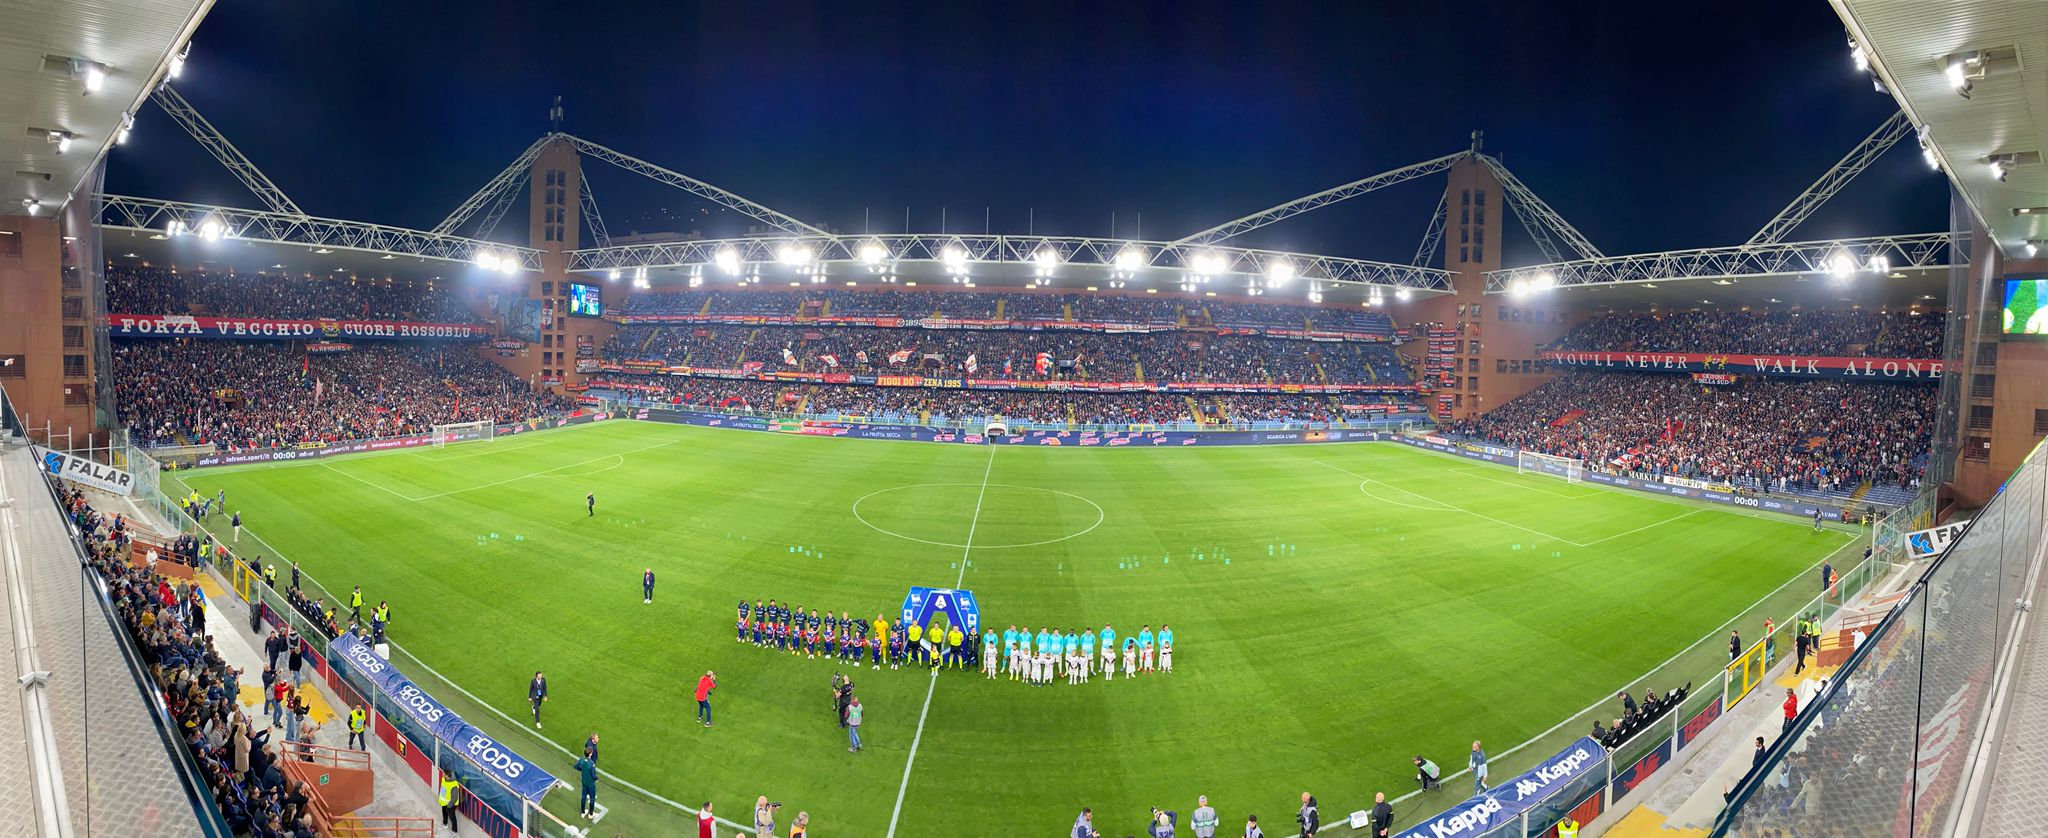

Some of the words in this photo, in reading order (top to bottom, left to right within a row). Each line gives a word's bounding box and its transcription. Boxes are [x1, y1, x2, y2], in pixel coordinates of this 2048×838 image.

[121, 318, 203, 334] FORZA
[216, 321, 314, 336] VECCHIO
[344, 324, 395, 336] CUORE
[400, 325, 470, 338] ROSSOBLU
[1556, 353, 1614, 366] YOU'LL
[1625, 354, 1688, 369] NEVER
[1753, 358, 1820, 374] WALK
[1844, 361, 1944, 378] ALONE
[878, 377, 900, 386] FIGGI
[924, 378, 942, 387] ZENA
[944, 380, 962, 388] 1995
[273, 452, 296, 460] 00:00
[69, 459, 130, 486] FALAR
[1628, 471, 1660, 482] MARKUP
[1734, 496, 1758, 507] 00:00
[358, 650, 384, 673] CDS
[411, 696, 443, 722] CDS
[482, 748, 524, 778] CDS
[1536, 748, 1591, 784] Kappa
[1429, 796, 1502, 838] Kappa
